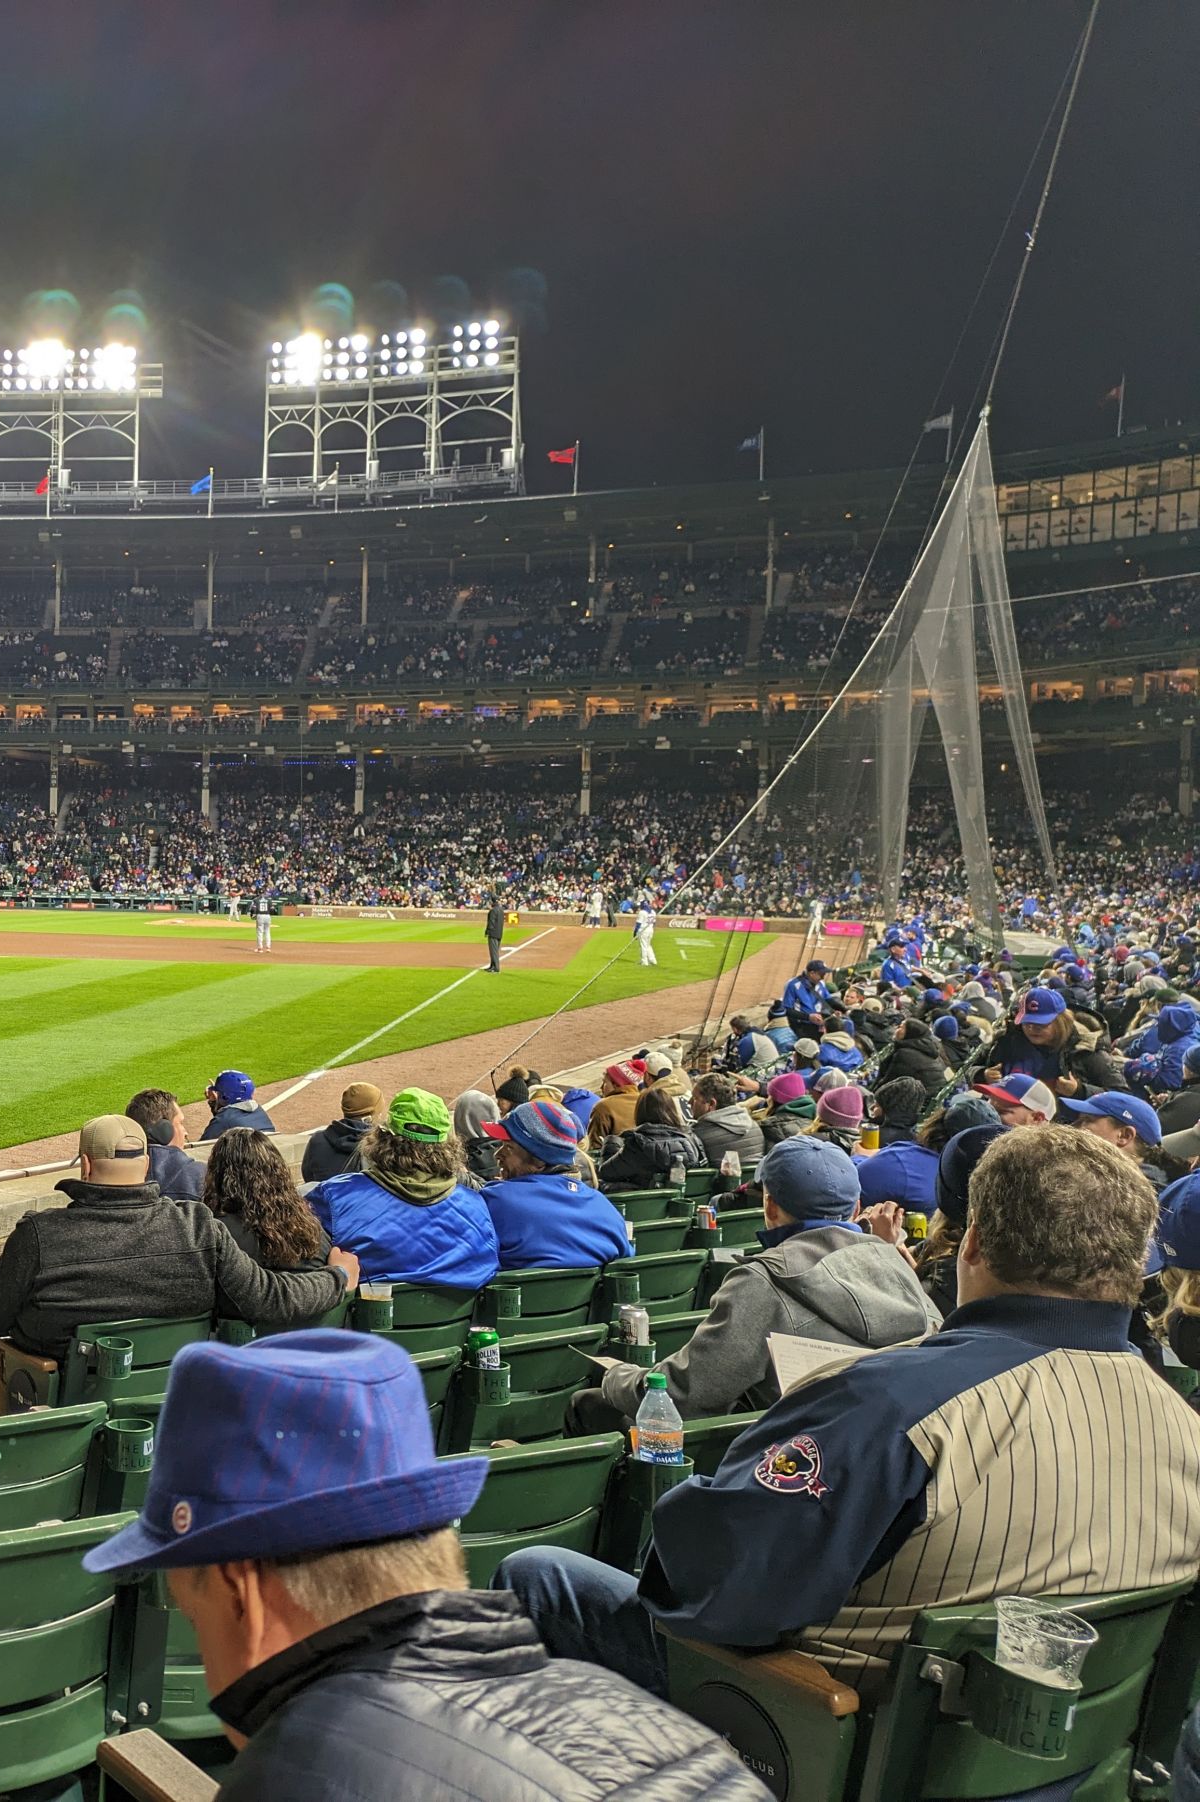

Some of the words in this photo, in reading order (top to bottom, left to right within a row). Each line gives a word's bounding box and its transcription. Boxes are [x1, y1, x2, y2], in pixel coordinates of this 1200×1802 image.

[358, 911, 388, 919] American
[758, 1467, 780, 1487] CUBS
[743, 1754, 775, 1777] CLUB
